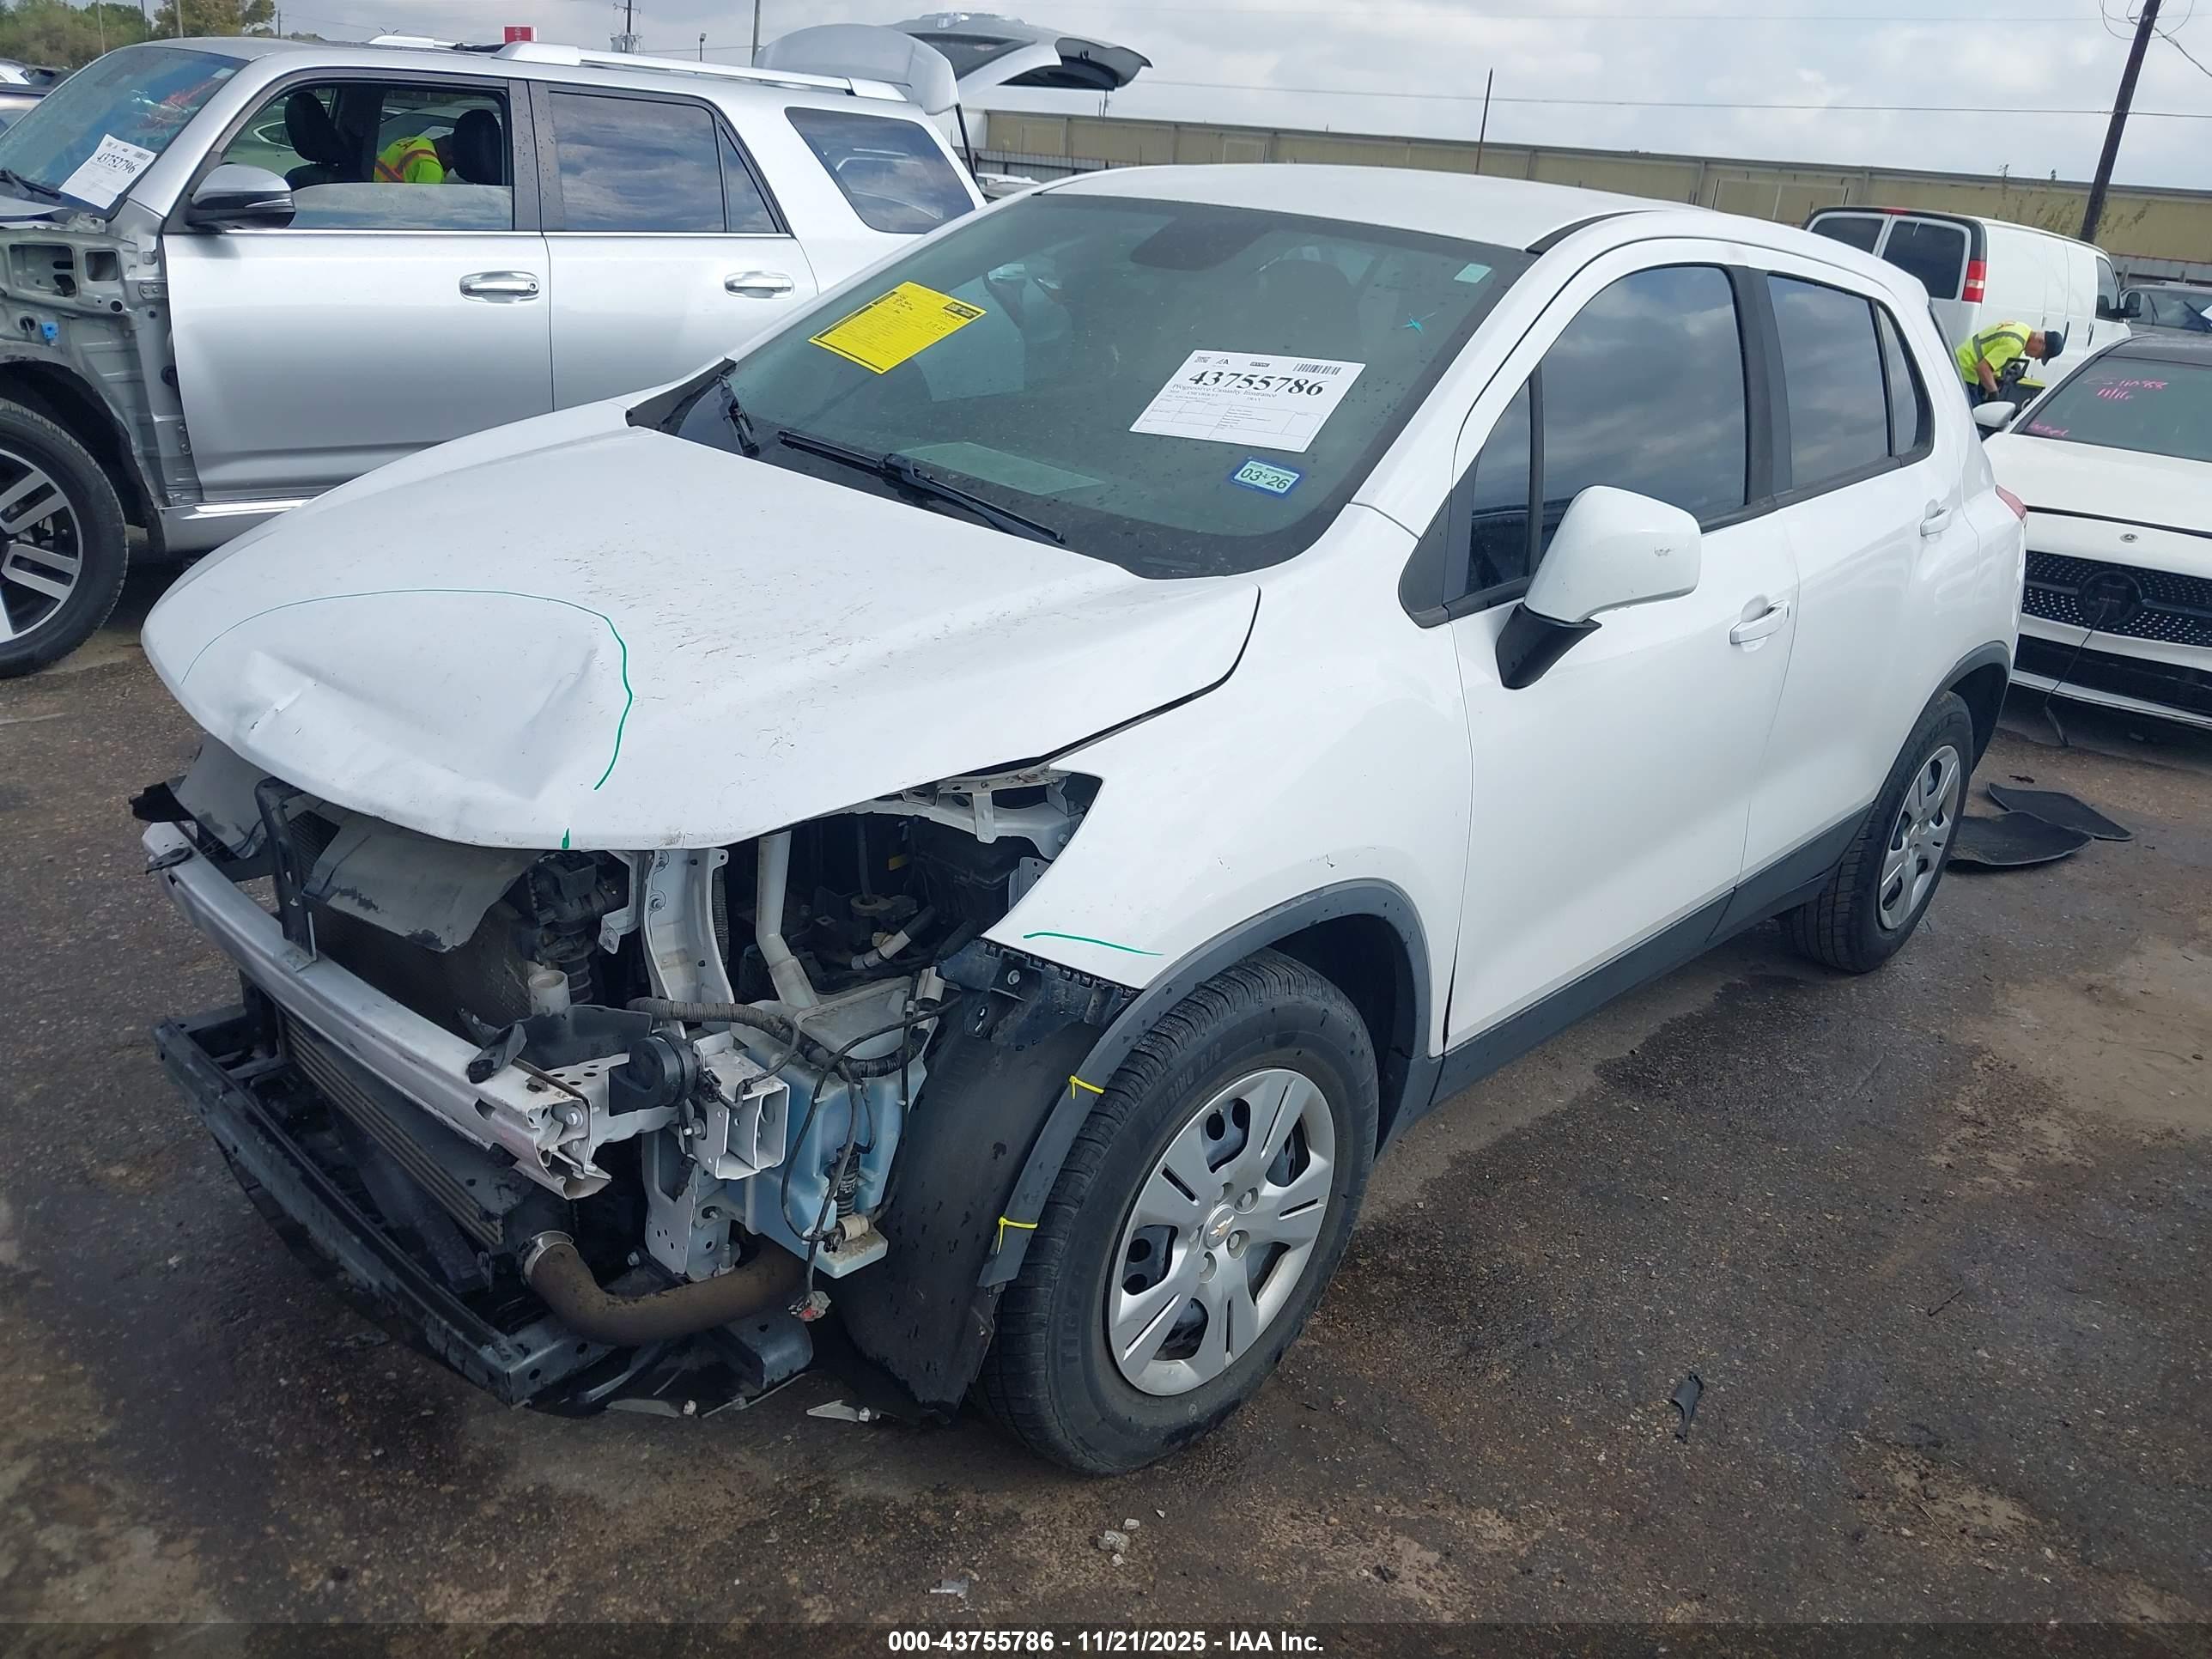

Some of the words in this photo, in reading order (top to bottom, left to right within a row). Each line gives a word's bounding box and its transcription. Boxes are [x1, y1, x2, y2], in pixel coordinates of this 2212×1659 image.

[96, 152, 138, 173] 43752796
[1188, 370, 1329, 396] 43755786
[1240, 468, 1263, 482] 03
[1265, 475, 1291, 489] 26
